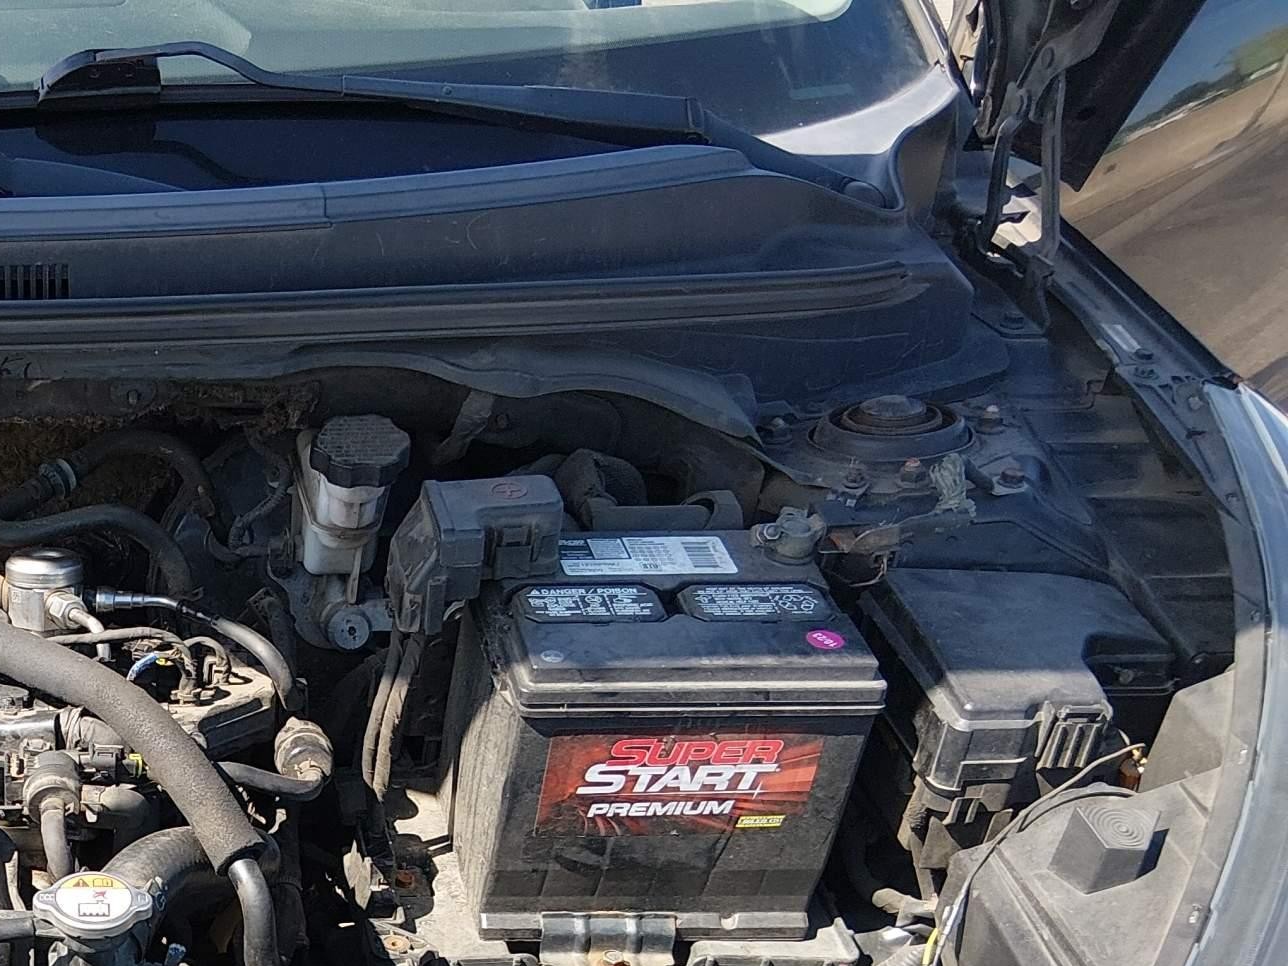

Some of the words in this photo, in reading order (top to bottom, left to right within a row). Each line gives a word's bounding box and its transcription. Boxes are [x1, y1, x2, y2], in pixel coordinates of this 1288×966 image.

[540, 588, 586, 596] DANGER
[606, 739, 785, 766] SUPER
[576, 764, 780, 795] START
[587, 799, 736, 818] PREMIUM
